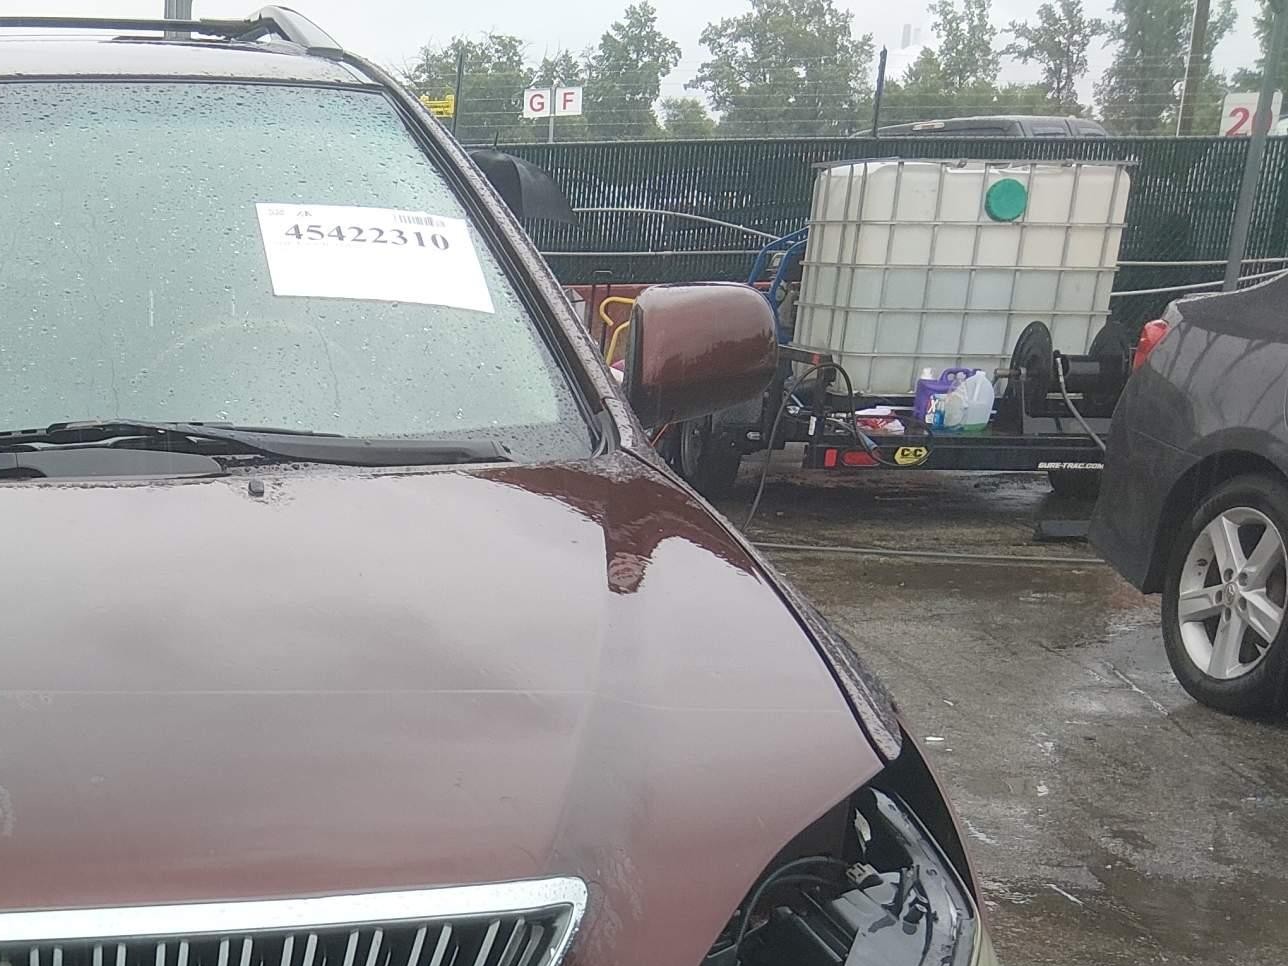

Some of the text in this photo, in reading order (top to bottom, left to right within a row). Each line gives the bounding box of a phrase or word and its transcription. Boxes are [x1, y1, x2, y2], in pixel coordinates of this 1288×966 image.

[529, 93, 545, 112] G
[562, 92, 575, 110] F
[1224, 106, 1273, 137] 2
[284, 223, 450, 251] 45422310
[1037, 461, 1105, 470] SURE-TRAC.COM
